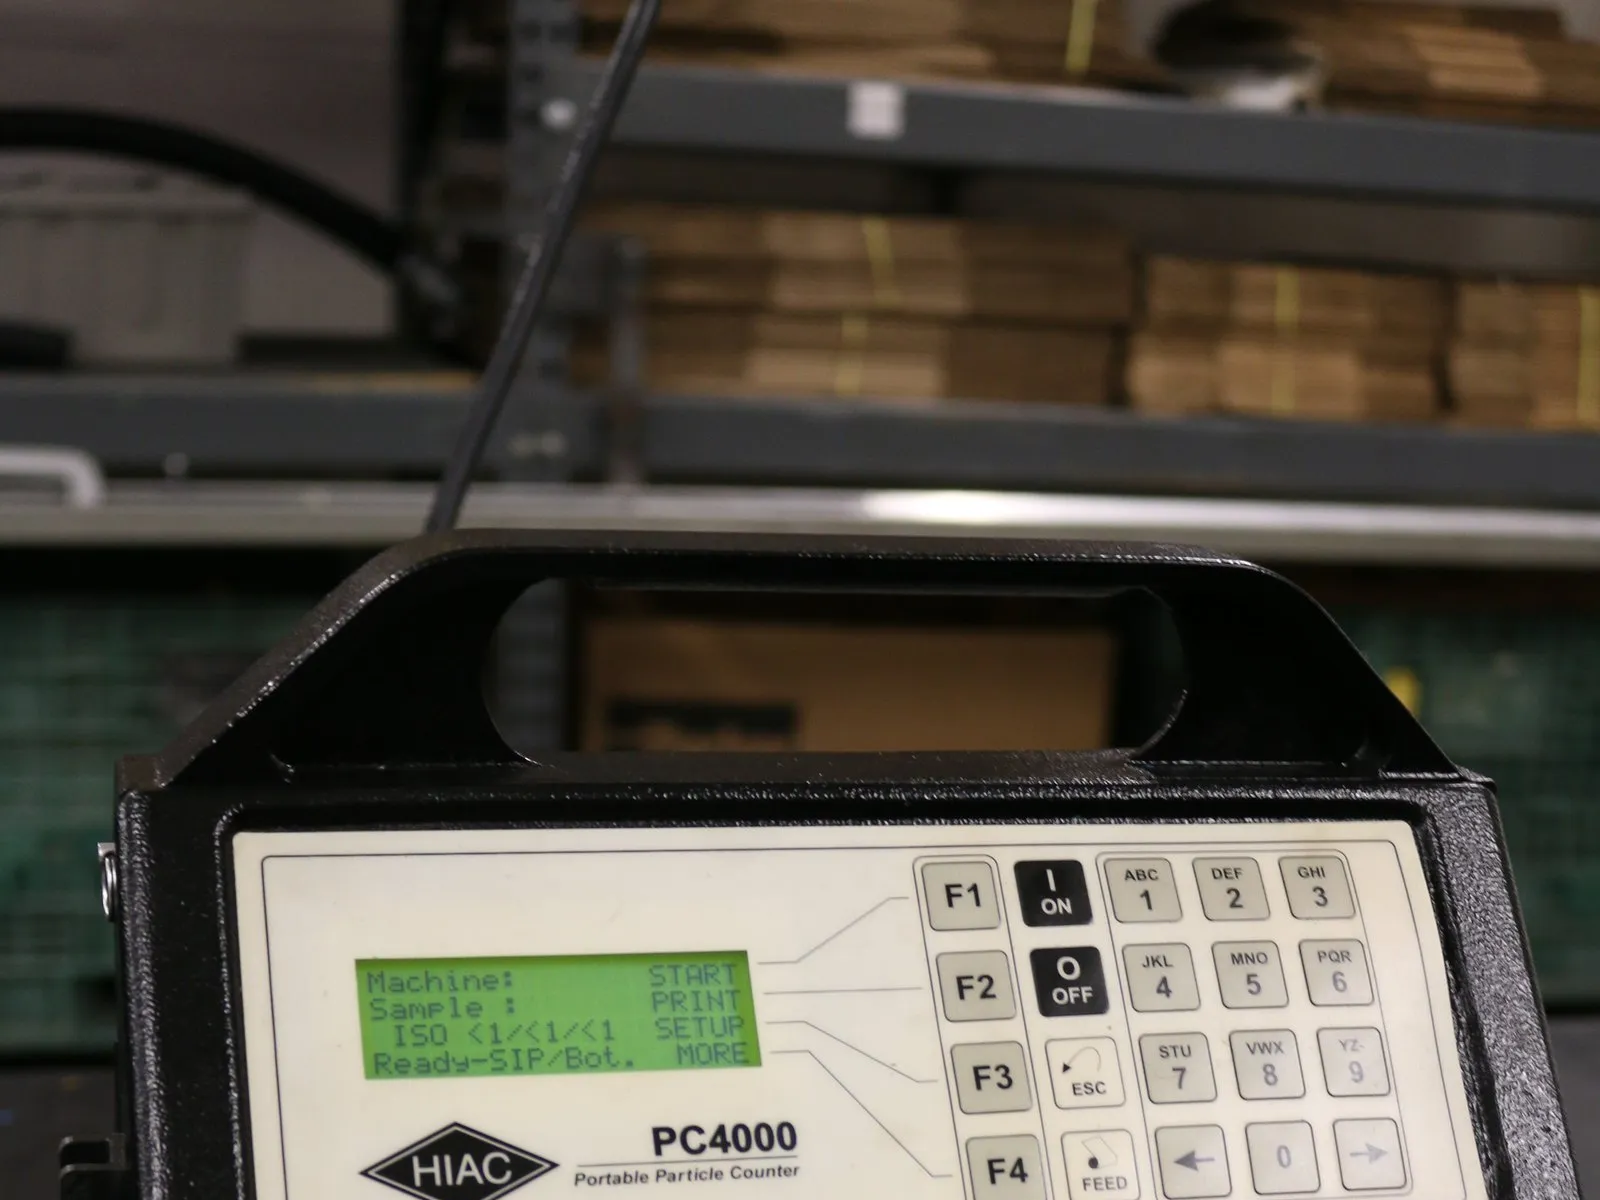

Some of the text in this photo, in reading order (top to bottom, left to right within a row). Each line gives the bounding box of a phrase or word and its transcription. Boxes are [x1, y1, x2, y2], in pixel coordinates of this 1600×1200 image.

[1124, 868, 1159, 882] ABC
[1211, 868, 1243, 880] DEF
[1298, 866, 1326, 878] GHI
[944, 883, 981, 908] F1
[1041, 898, 1073, 915] ON
[1140, 890, 1153, 911] 1
[1226, 888, 1244, 908] 2
[1312, 886, 1328, 906] 3
[1142, 956, 1174, 968] JKL
[1231, 952, 1268, 965] MNO
[1318, 950, 1352, 963] PQR
[367, 970, 515, 994] Machine:
[650, 963, 738, 987] START
[1246, 974, 1262, 994] 5
[1332, 972, 1348, 992] 6
[956, 974, 996, 1000] F2
[1052, 986, 1093, 1005] OFF
[1156, 976, 1172, 998] 4
[369, 998, 484, 1021] Sample
[651, 990, 741, 1013] PRINT
[394, 1023, 448, 1047] ISO
[655, 1016, 745, 1041] SETUP
[676, 1043, 749, 1066] MORE
[1159, 1046, 1192, 1058] STU
[1246, 1042, 1284, 1055] VWX
[373, 1047, 635, 1076] Ready-SIP/Bot.
[1350, 1061, 1364, 1083] 9
[972, 1064, 1013, 1091] F3
[1172, 1067, 1186, 1090] 7
[1262, 1064, 1278, 1086] 8
[1071, 1081, 1107, 1096] ESC
[652, 1121, 797, 1157] PC4000
[1276, 1144, 1292, 1168] 0
[412, 1151, 512, 1188] HIAC
[574, 1163, 799, 1188] Portable Particle Counter
[987, 1157, 1028, 1185] F4
[1082, 1176, 1128, 1191] FEED
